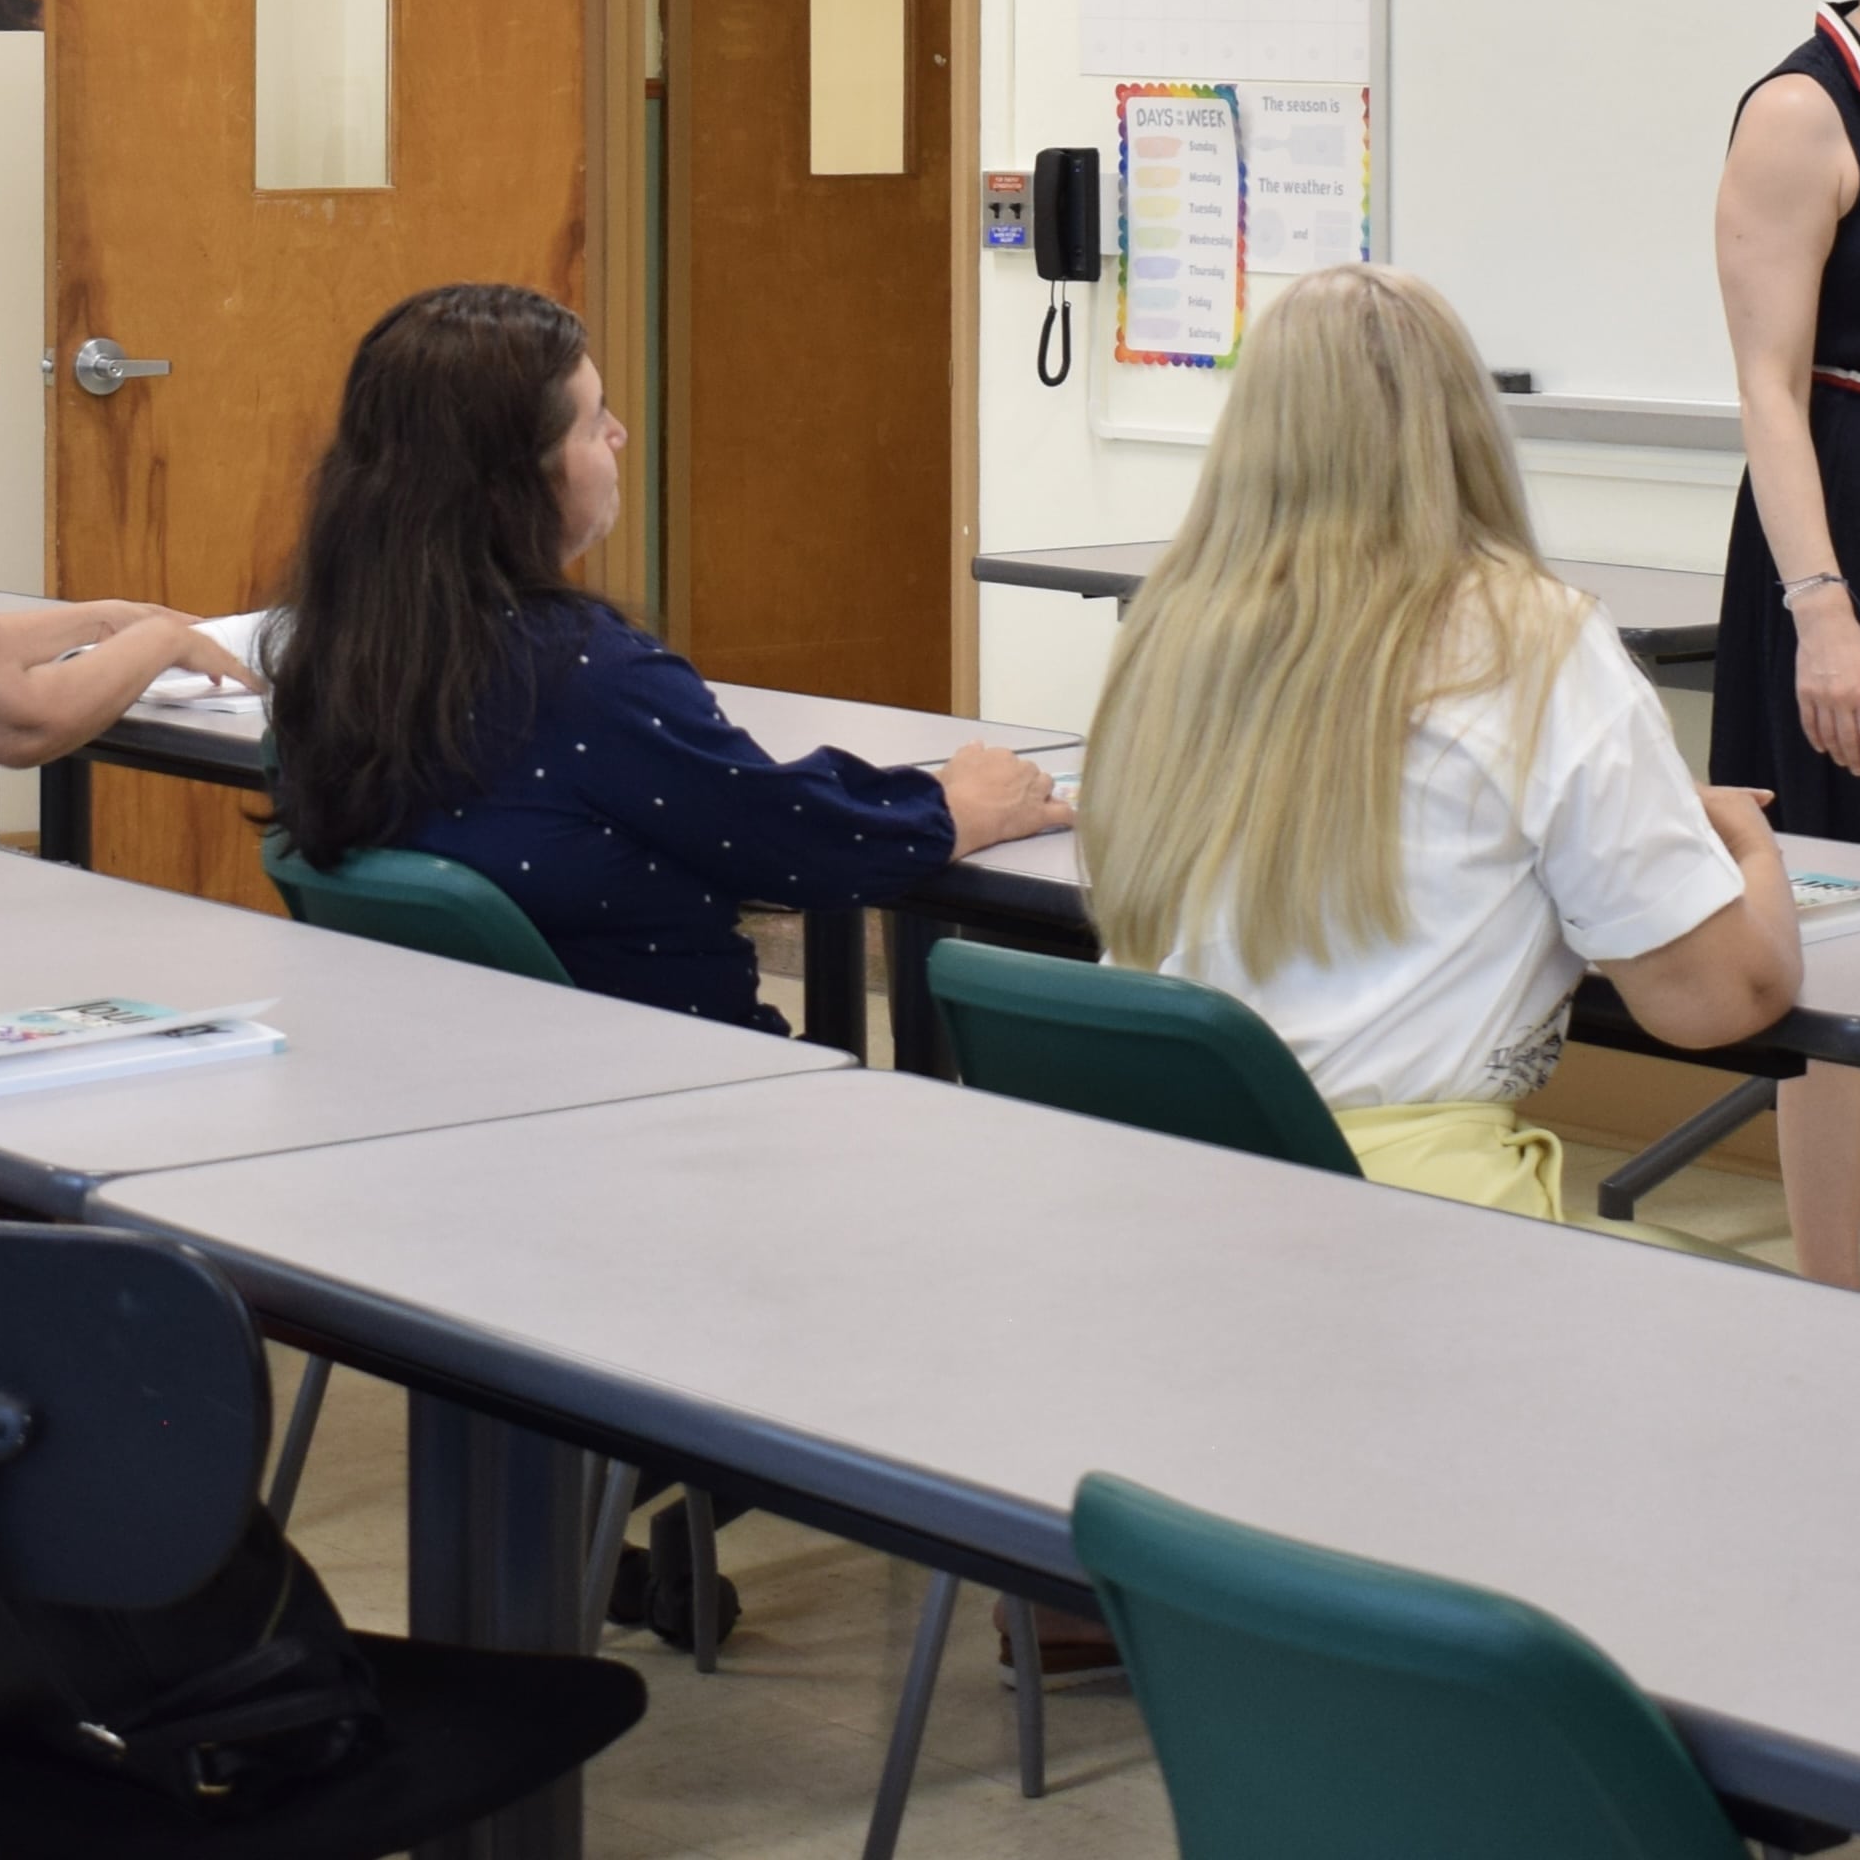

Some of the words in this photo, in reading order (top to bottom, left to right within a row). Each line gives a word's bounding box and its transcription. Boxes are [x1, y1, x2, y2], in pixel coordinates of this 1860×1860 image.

[1262, 96, 1284, 112] The
[1287, 100, 1327, 113] season
[1330, 98, 1341, 113] is
[1136, 108, 1173, 127] DAYS
[1186, 109, 1226, 129] WEEK
[1258, 178, 1280, 194] The
[1283, 180, 1331, 196] weather
[1334, 181, 1344, 196] is
[1292, 229, 1309, 240] and
